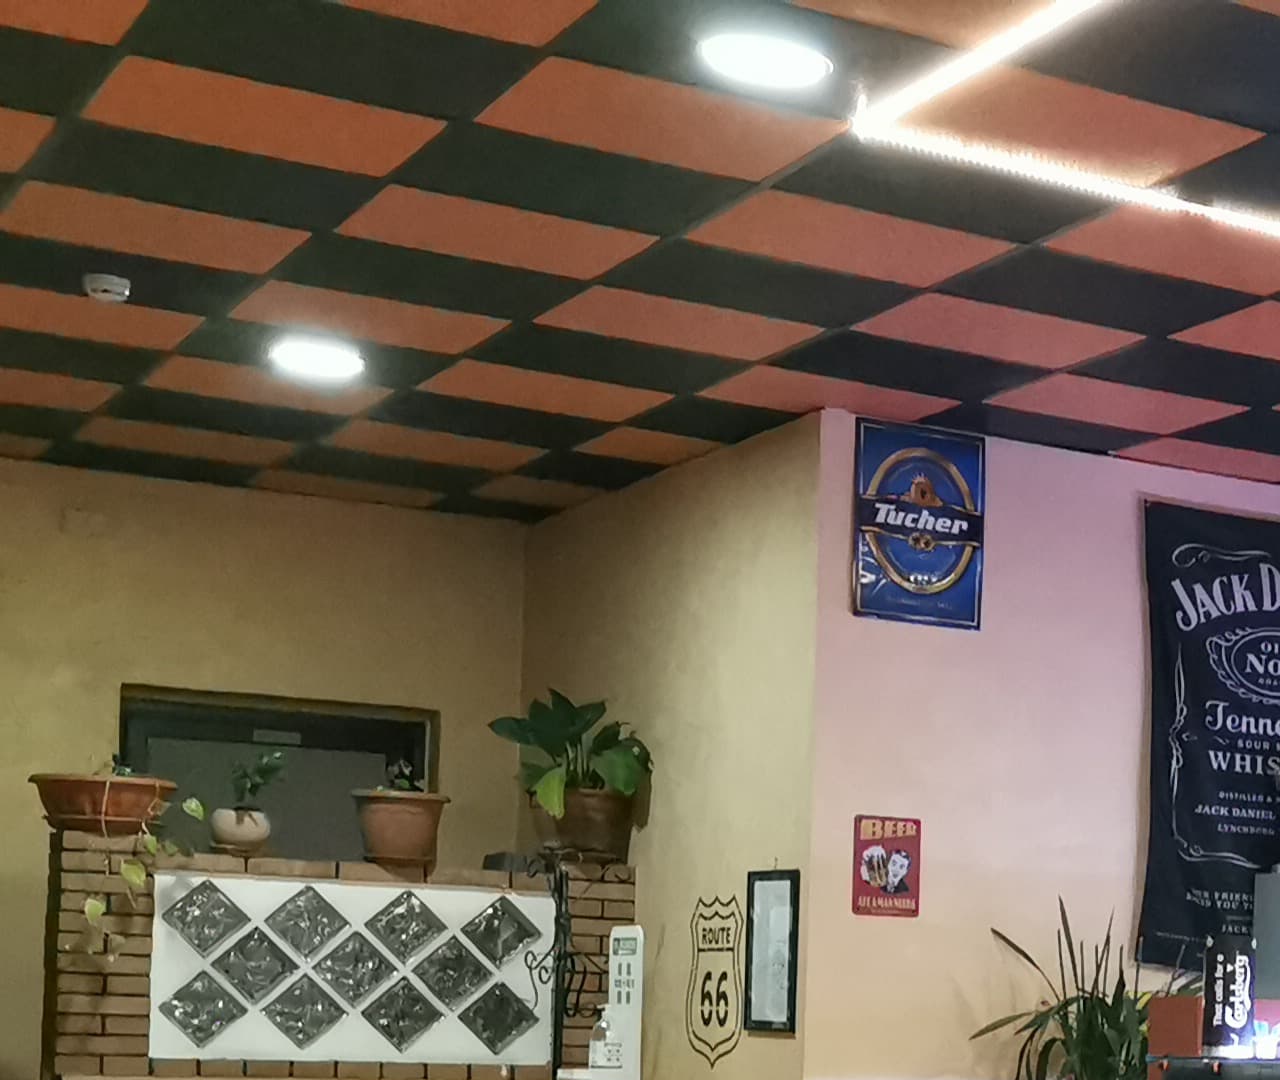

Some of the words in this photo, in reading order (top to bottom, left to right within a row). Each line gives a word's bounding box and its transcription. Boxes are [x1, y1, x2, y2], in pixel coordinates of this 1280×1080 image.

[874, 503, 969, 535] Tucher
[1171, 573, 1259, 631] JACK
[1238, 738, 1270, 750] SOUR
[1194, 804, 1229, 816] JACK
[860, 819, 917, 840] BEER
[701, 926, 731, 945] ROUTE
[700, 970, 729, 1028] 66
[1225, 950, 1252, 1029] Carlsberg
